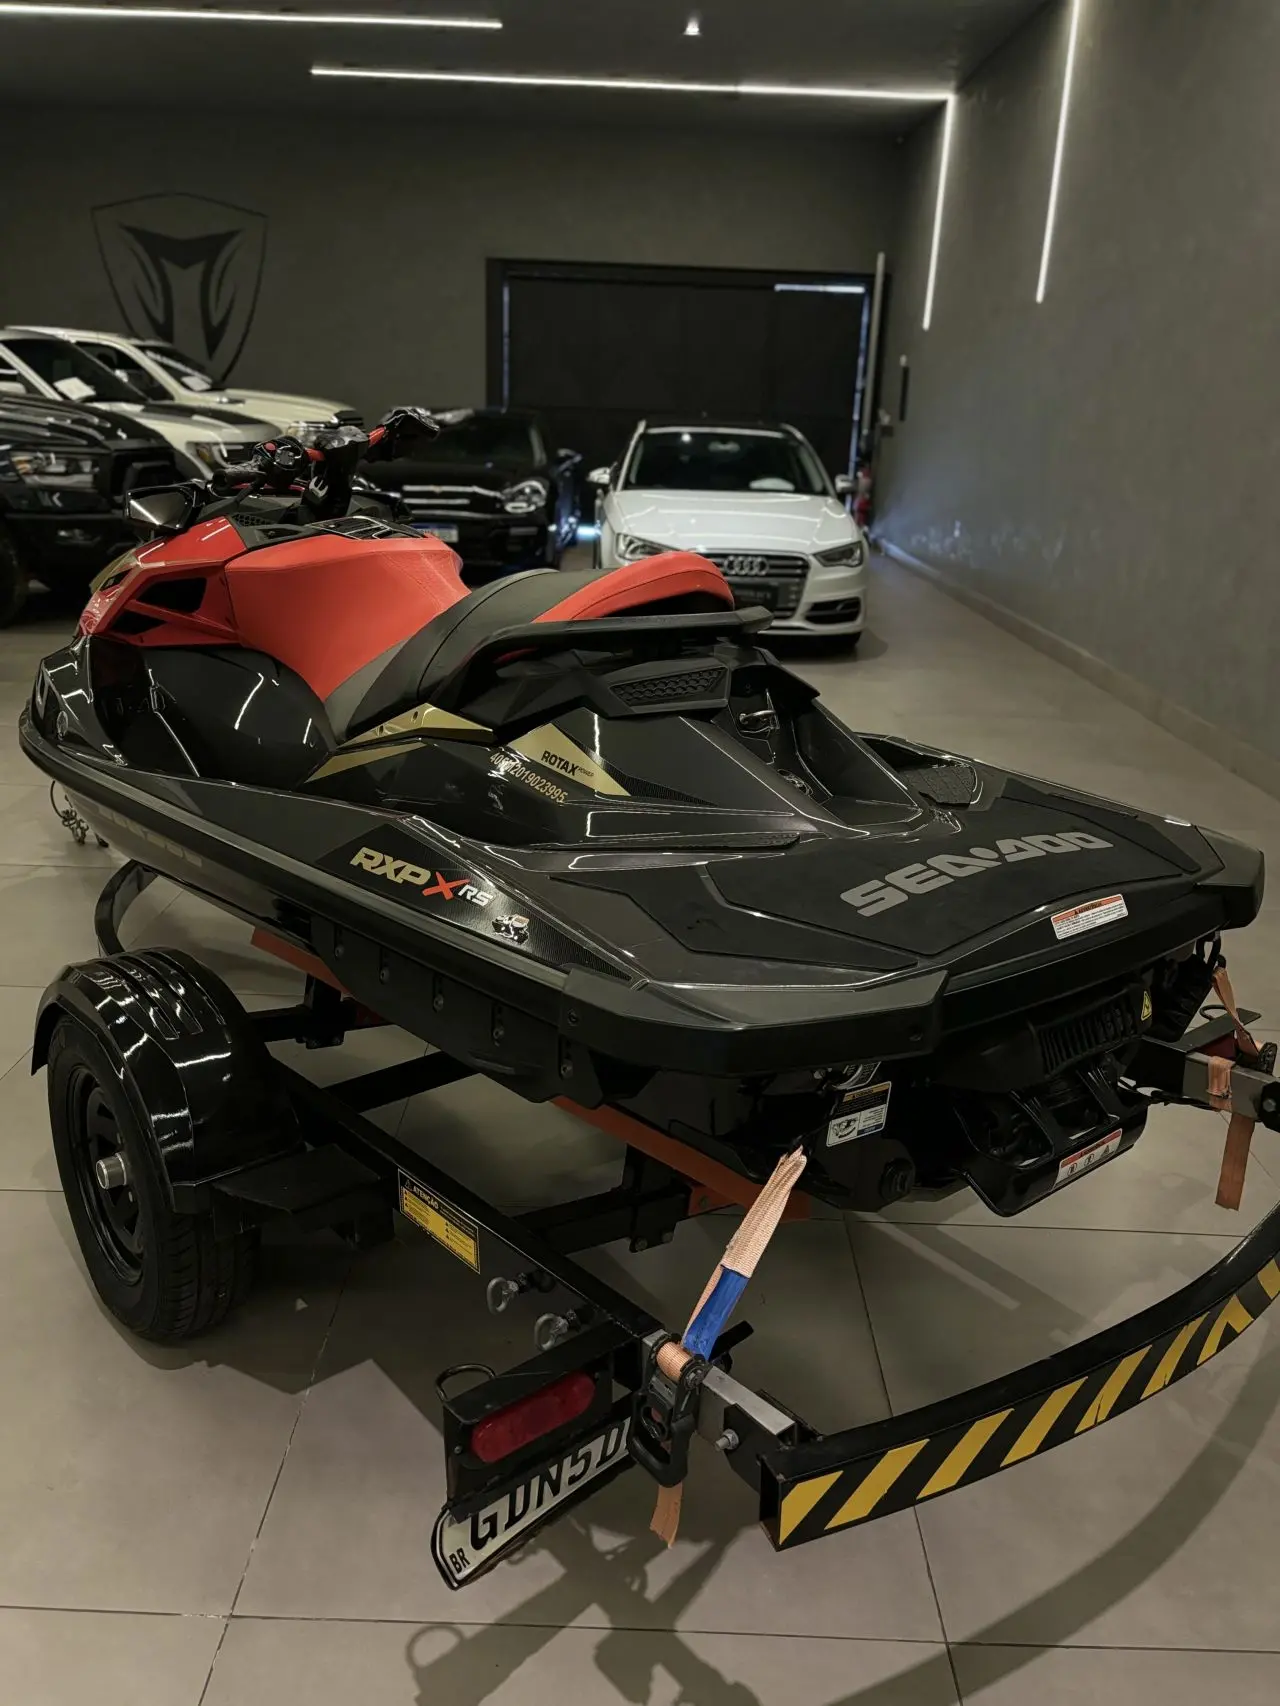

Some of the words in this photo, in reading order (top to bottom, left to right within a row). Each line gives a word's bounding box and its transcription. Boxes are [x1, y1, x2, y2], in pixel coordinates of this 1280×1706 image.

[541, 750, 579, 776] ROTAX
[349, 846, 432, 886] RXP
[421, 871, 471, 900] X
[457, 884, 495, 907] RS
[448, 1546, 471, 1574] BR
